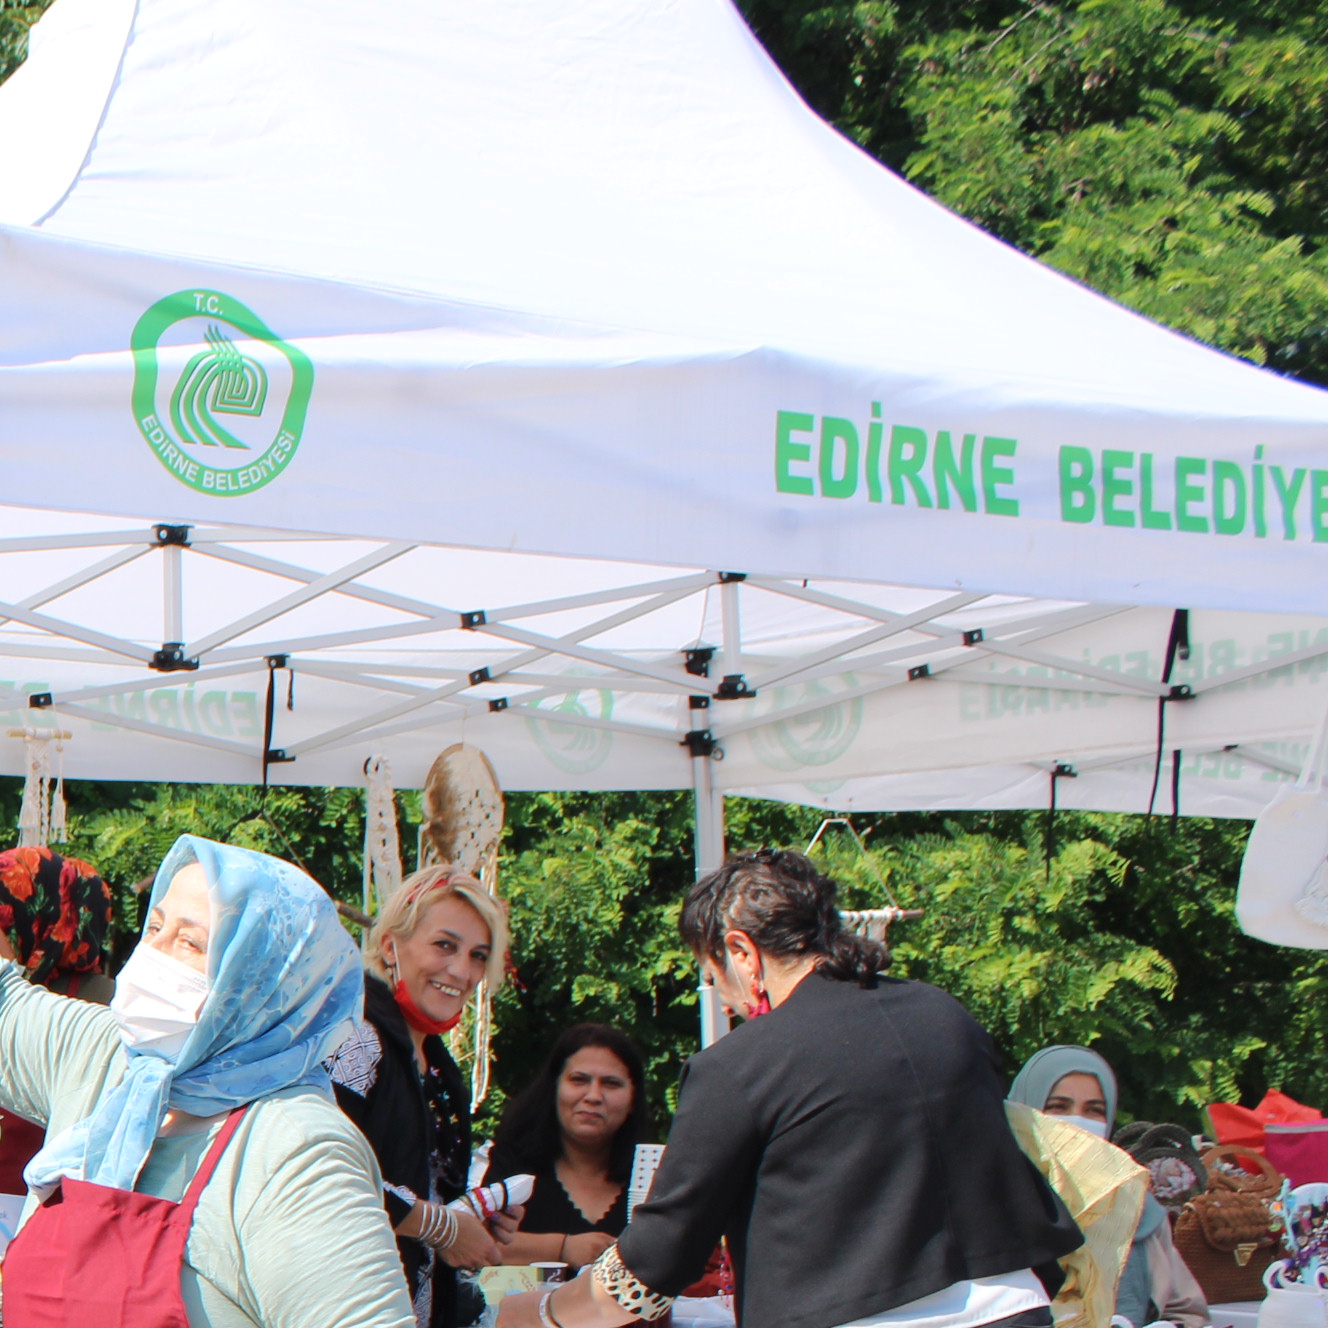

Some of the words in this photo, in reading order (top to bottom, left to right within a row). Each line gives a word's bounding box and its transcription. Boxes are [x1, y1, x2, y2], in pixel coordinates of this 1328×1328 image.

[193, 291, 224, 316] T.C.
[141, 413, 201, 482] EDİRNE
[202, 429, 296, 491] BELEDİYESİ
[774, 400, 1021, 518] EDİRNE
